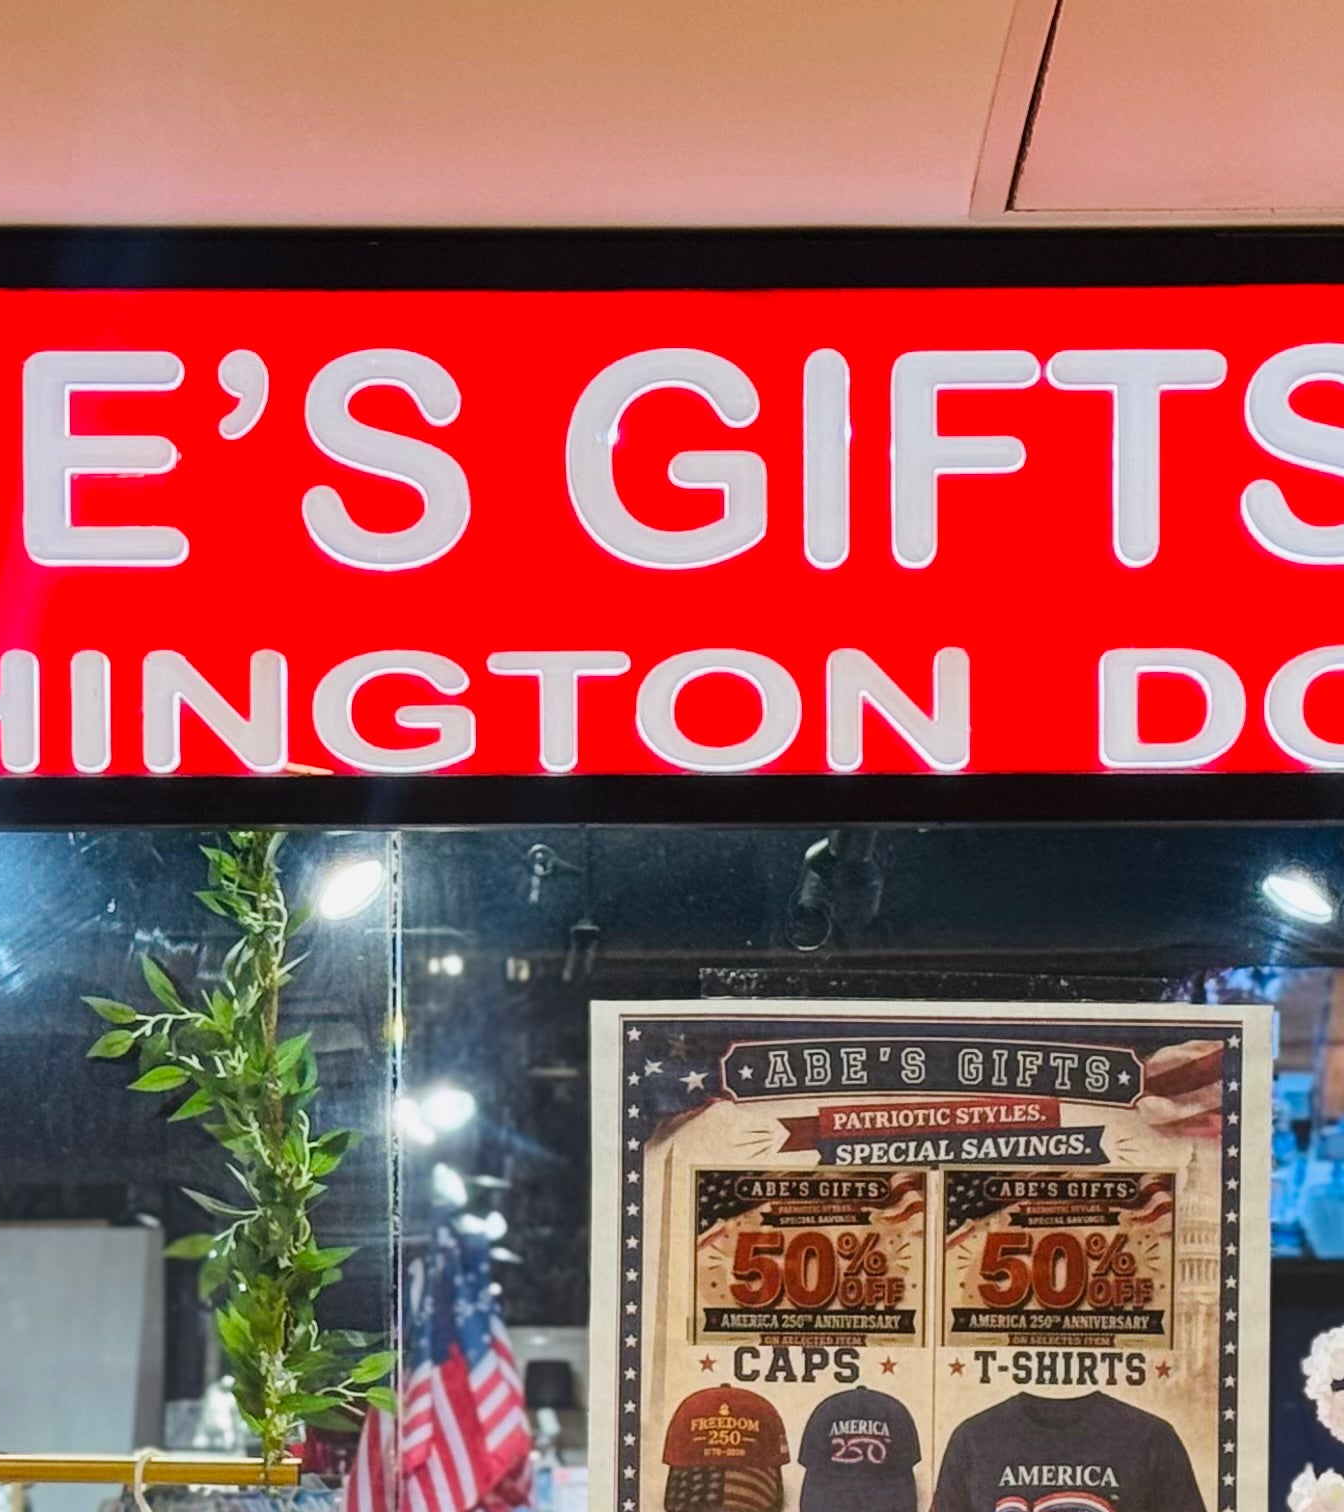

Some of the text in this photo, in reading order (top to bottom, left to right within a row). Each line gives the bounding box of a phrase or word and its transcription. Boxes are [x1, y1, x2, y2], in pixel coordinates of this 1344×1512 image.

[764, 1046, 1111, 1093] ABE'S GIFTS
[832, 1104, 1047, 1131] PATRIOTIC STYLES.
[835, 1133, 1091, 1165] SPECIAL SAVINGS.
[750, 1180, 879, 1198] ABE'S GIFTS
[999, 1181, 1128, 1198] ABE'S GIFTS
[729, 1231, 889, 1309] 50%
[976, 1232, 1137, 1309] 50%
[837, 1277, 905, 1308] OFF
[1086, 1277, 1154, 1308] OFF
[721, 1313, 778, 1329] AMERICA
[814, 1314, 901, 1330] ANNIVERSARY
[969, 1314, 1026, 1329] AMERICA
[1062, 1315, 1150, 1330] ANNIVERSARY
[733, 1346, 861, 1383] CAPS
[974, 1350, 1146, 1386] T-SHIRTS
[690, 1416, 759, 1432] FREEDOM
[707, 1430, 742, 1445] 250
[829, 1419, 890, 1436] AMERICA
[831, 1437, 887, 1464] 250
[998, 1465, 1120, 1488] AMERICA
